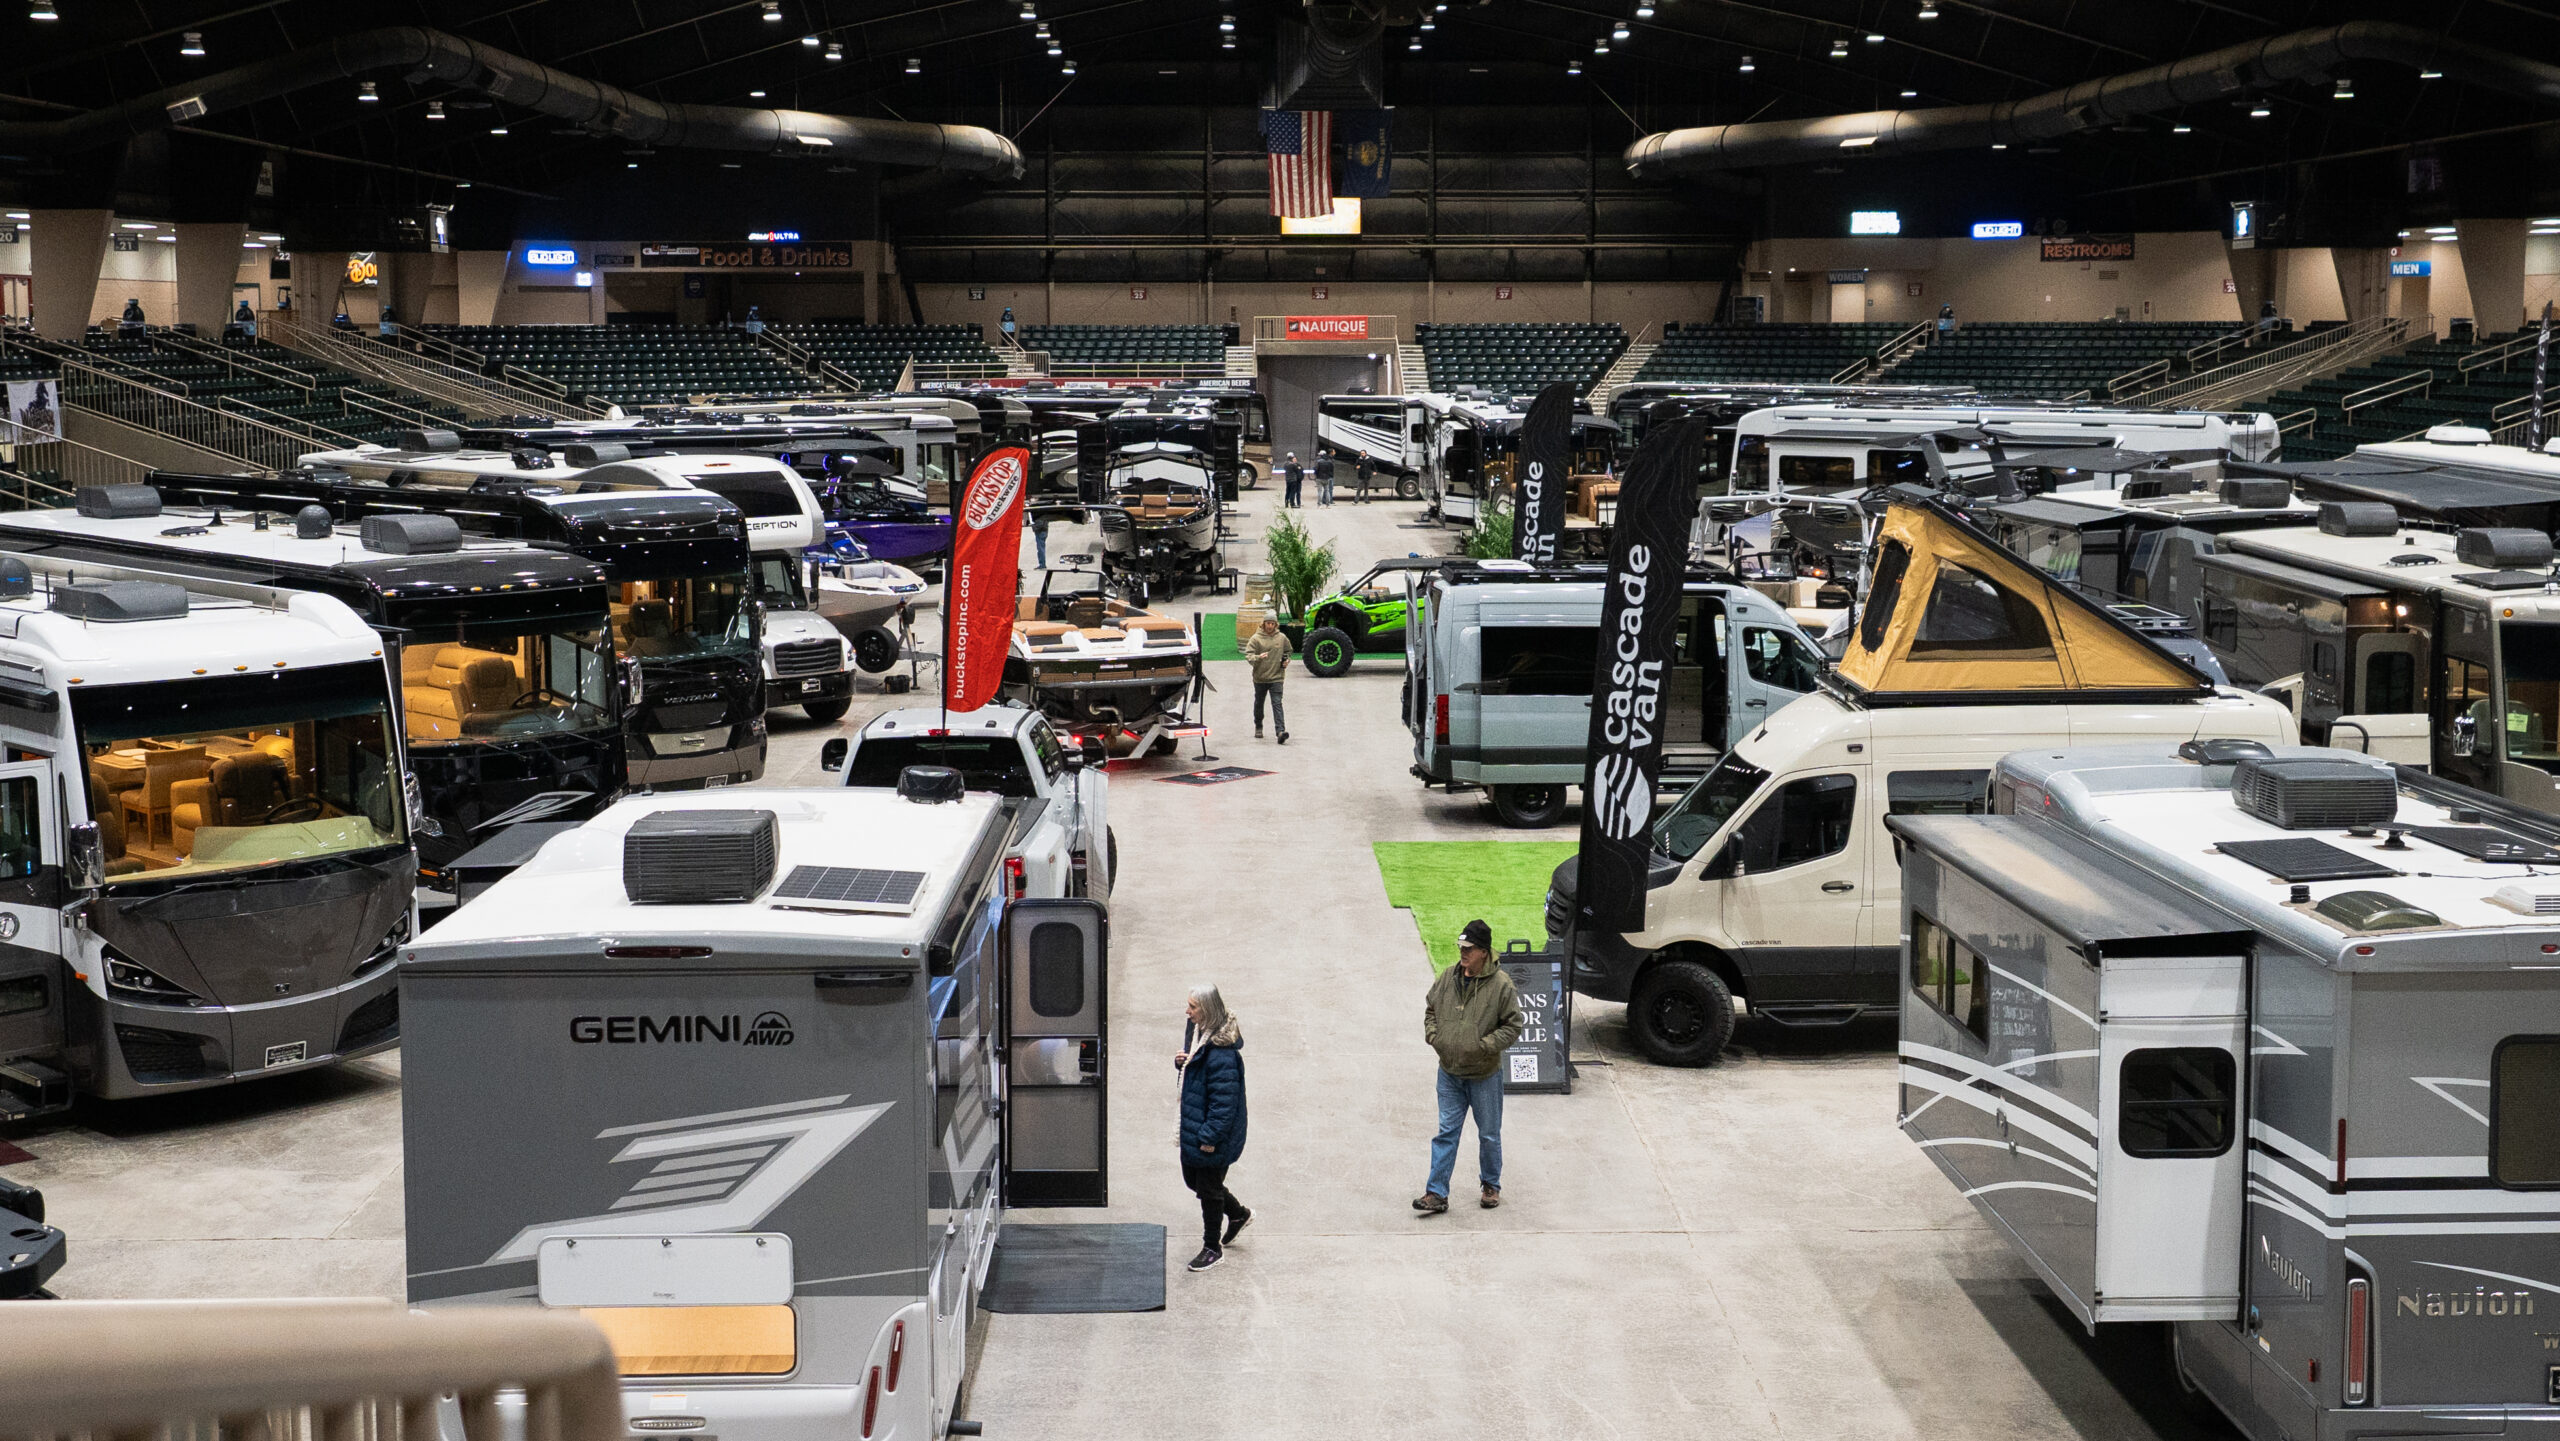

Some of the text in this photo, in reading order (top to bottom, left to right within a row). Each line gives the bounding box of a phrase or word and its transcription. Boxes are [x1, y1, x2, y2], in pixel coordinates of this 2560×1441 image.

[120, 241, 132, 250] 21
[774, 232, 799, 240] ULTRA
[279, 252, 290, 260] 22
[700, 247, 850, 266] Food & Drinks
[2044, 244, 2132, 258] RESTROOMS
[1828, 271, 1865, 283] WOMEN
[2392, 263, 2420, 275] MEN
[1300, 320, 1366, 333] NAUTIQUE
[1199, 379, 1251, 387] AMERICAN BEERS
[968, 460, 1014, 524] BUCKSTOP
[986, 475, 1019, 521] Truckware
[953, 564, 971, 699] buckstopinc.com
[1604, 544, 1651, 745] cascade
[1629, 659, 1663, 750] van
[570, 1015, 795, 1046] GEMINI AWD
[2261, 1235, 2312, 1302] Navion
[2397, 1286, 2534, 1317] Navion
